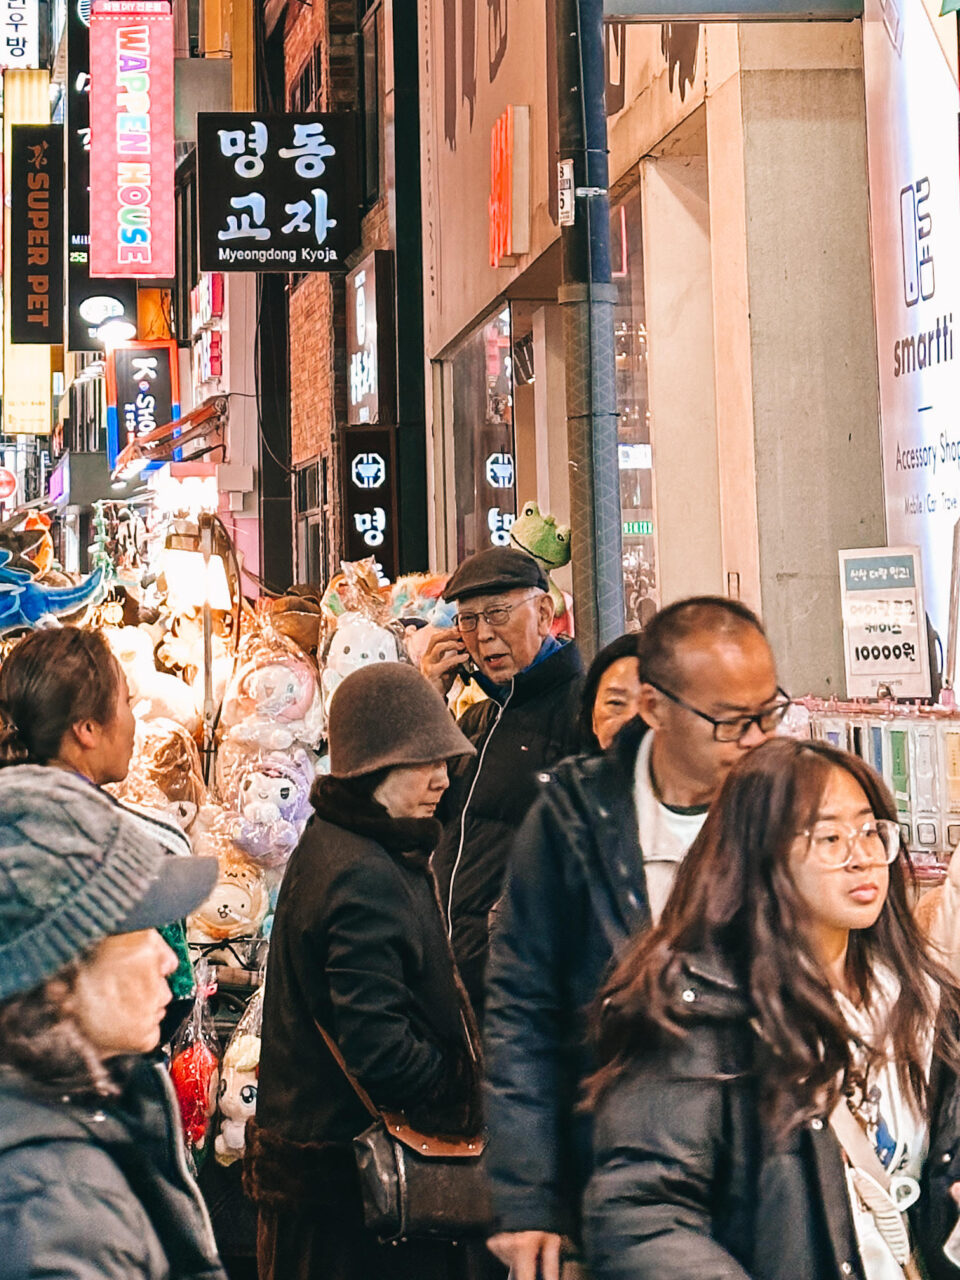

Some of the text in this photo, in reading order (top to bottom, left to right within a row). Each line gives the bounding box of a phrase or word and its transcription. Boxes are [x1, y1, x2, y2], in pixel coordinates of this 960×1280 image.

[116, 25, 152, 265] WAPPEN HOUSE
[218, 121, 336, 178] 명동
[218, 188, 337, 245] 교자
[27, 172, 50, 328] SUPER PET
[218, 248, 337, 263] Myeongdong Kyoja
[894, 312, 953, 378] smartti
[896, 440, 937, 475] Accessory
[855, 642, 915, 662] 10000원
